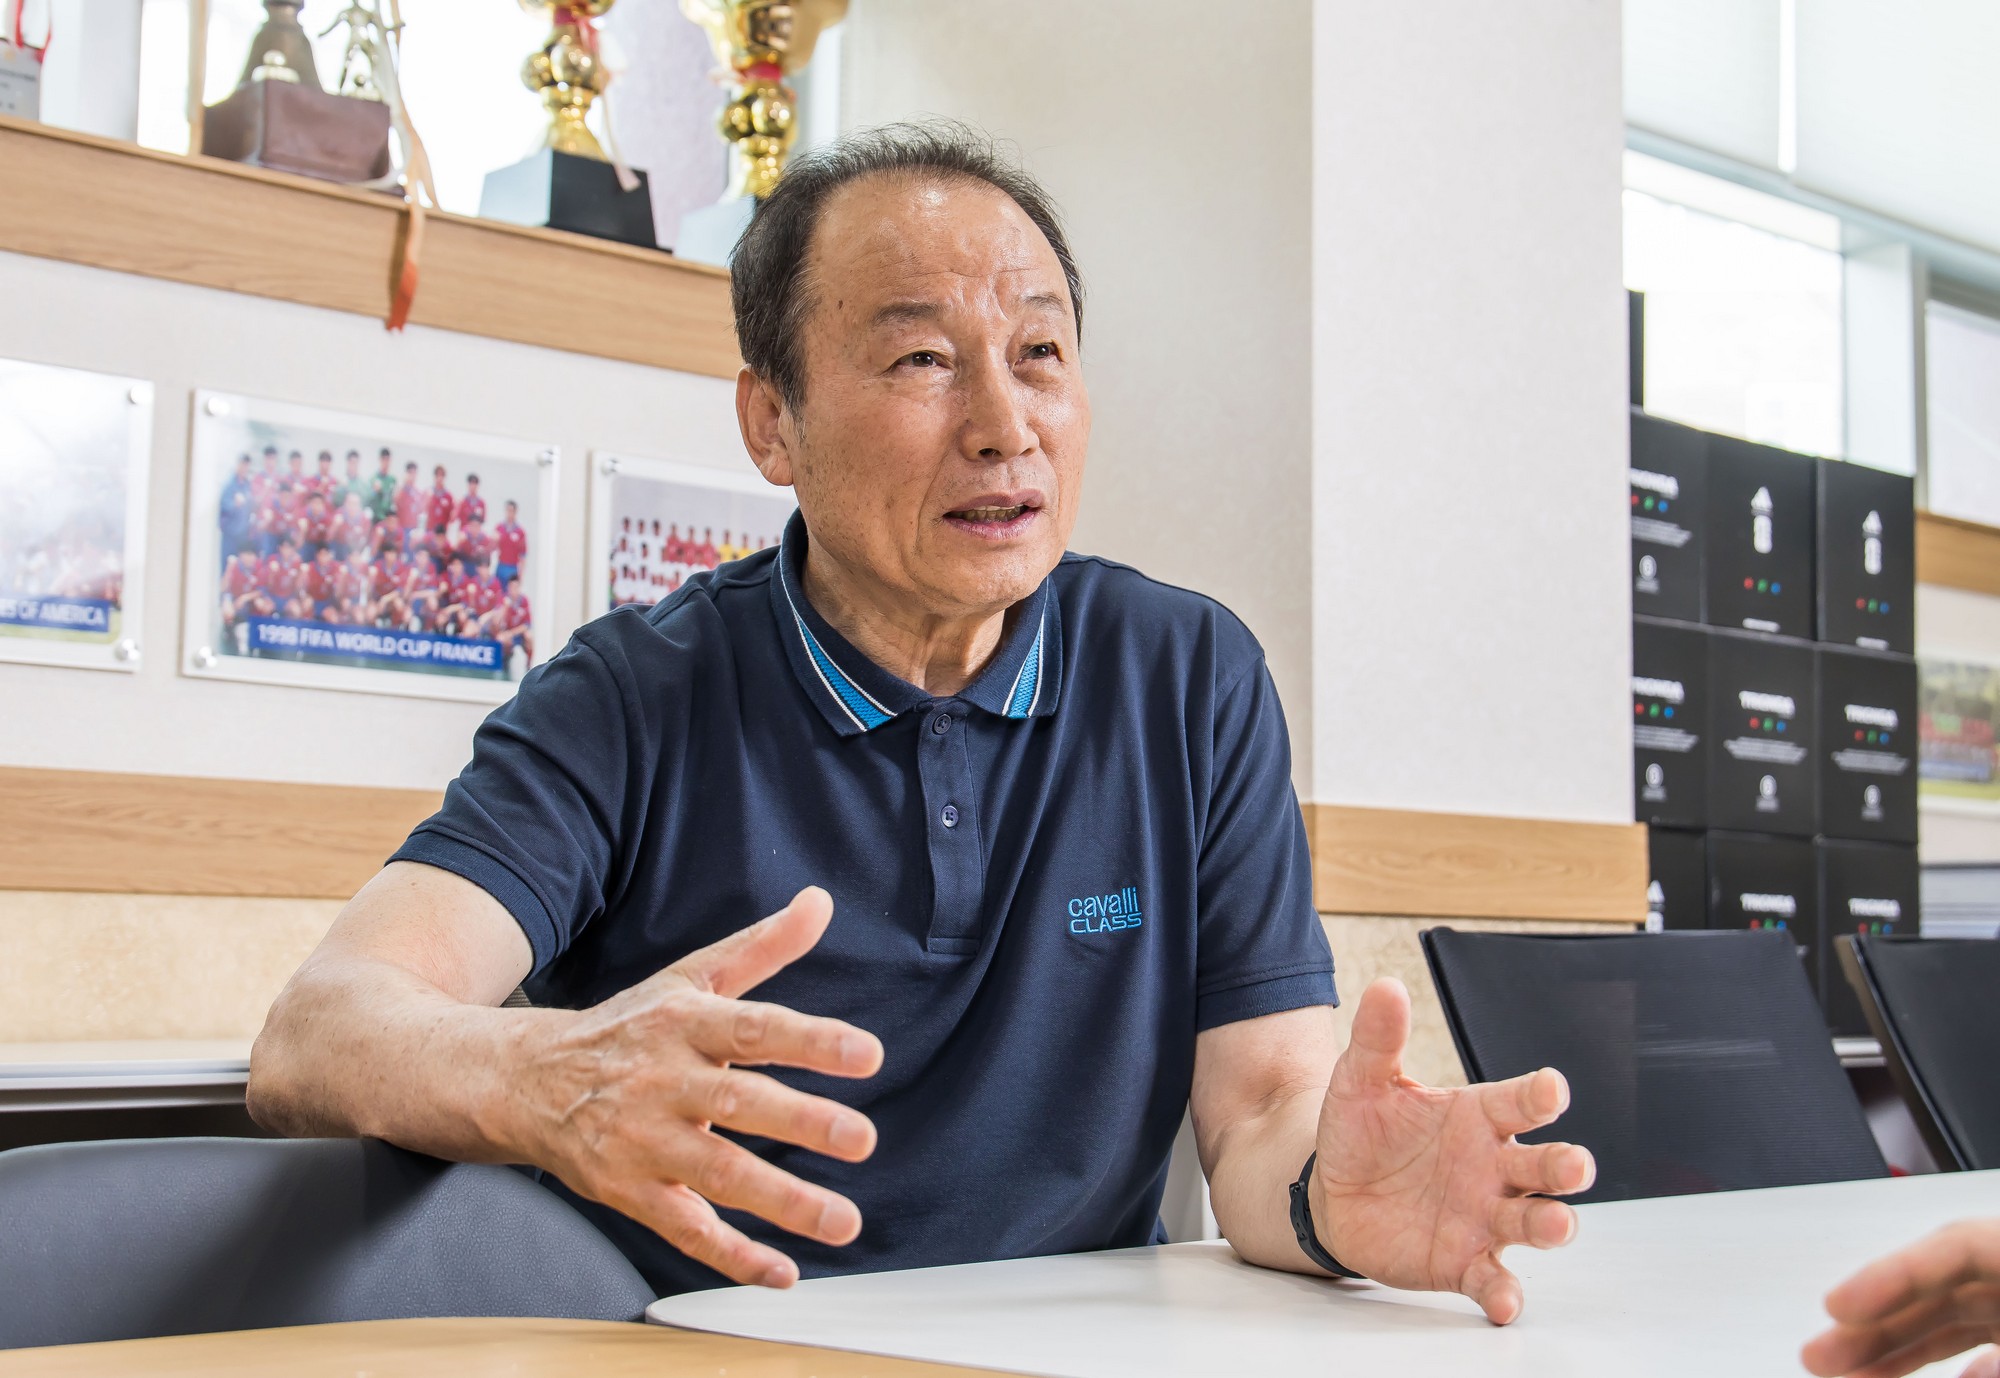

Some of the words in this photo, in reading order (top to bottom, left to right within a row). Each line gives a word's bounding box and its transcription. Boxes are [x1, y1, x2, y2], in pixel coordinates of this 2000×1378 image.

[18, 600, 38, 620] OF
[40, 602, 105, 625] AMERICA
[257, 624, 298, 646] 1998
[300, 627, 334, 649] FIFA
[334, 631, 397, 656] WORLD
[397, 637, 432, 658] CUP
[432, 640, 495, 665] FRANCE
[1068, 887, 1139, 917] cavalli
[1070, 912, 1142, 934] CLASS
